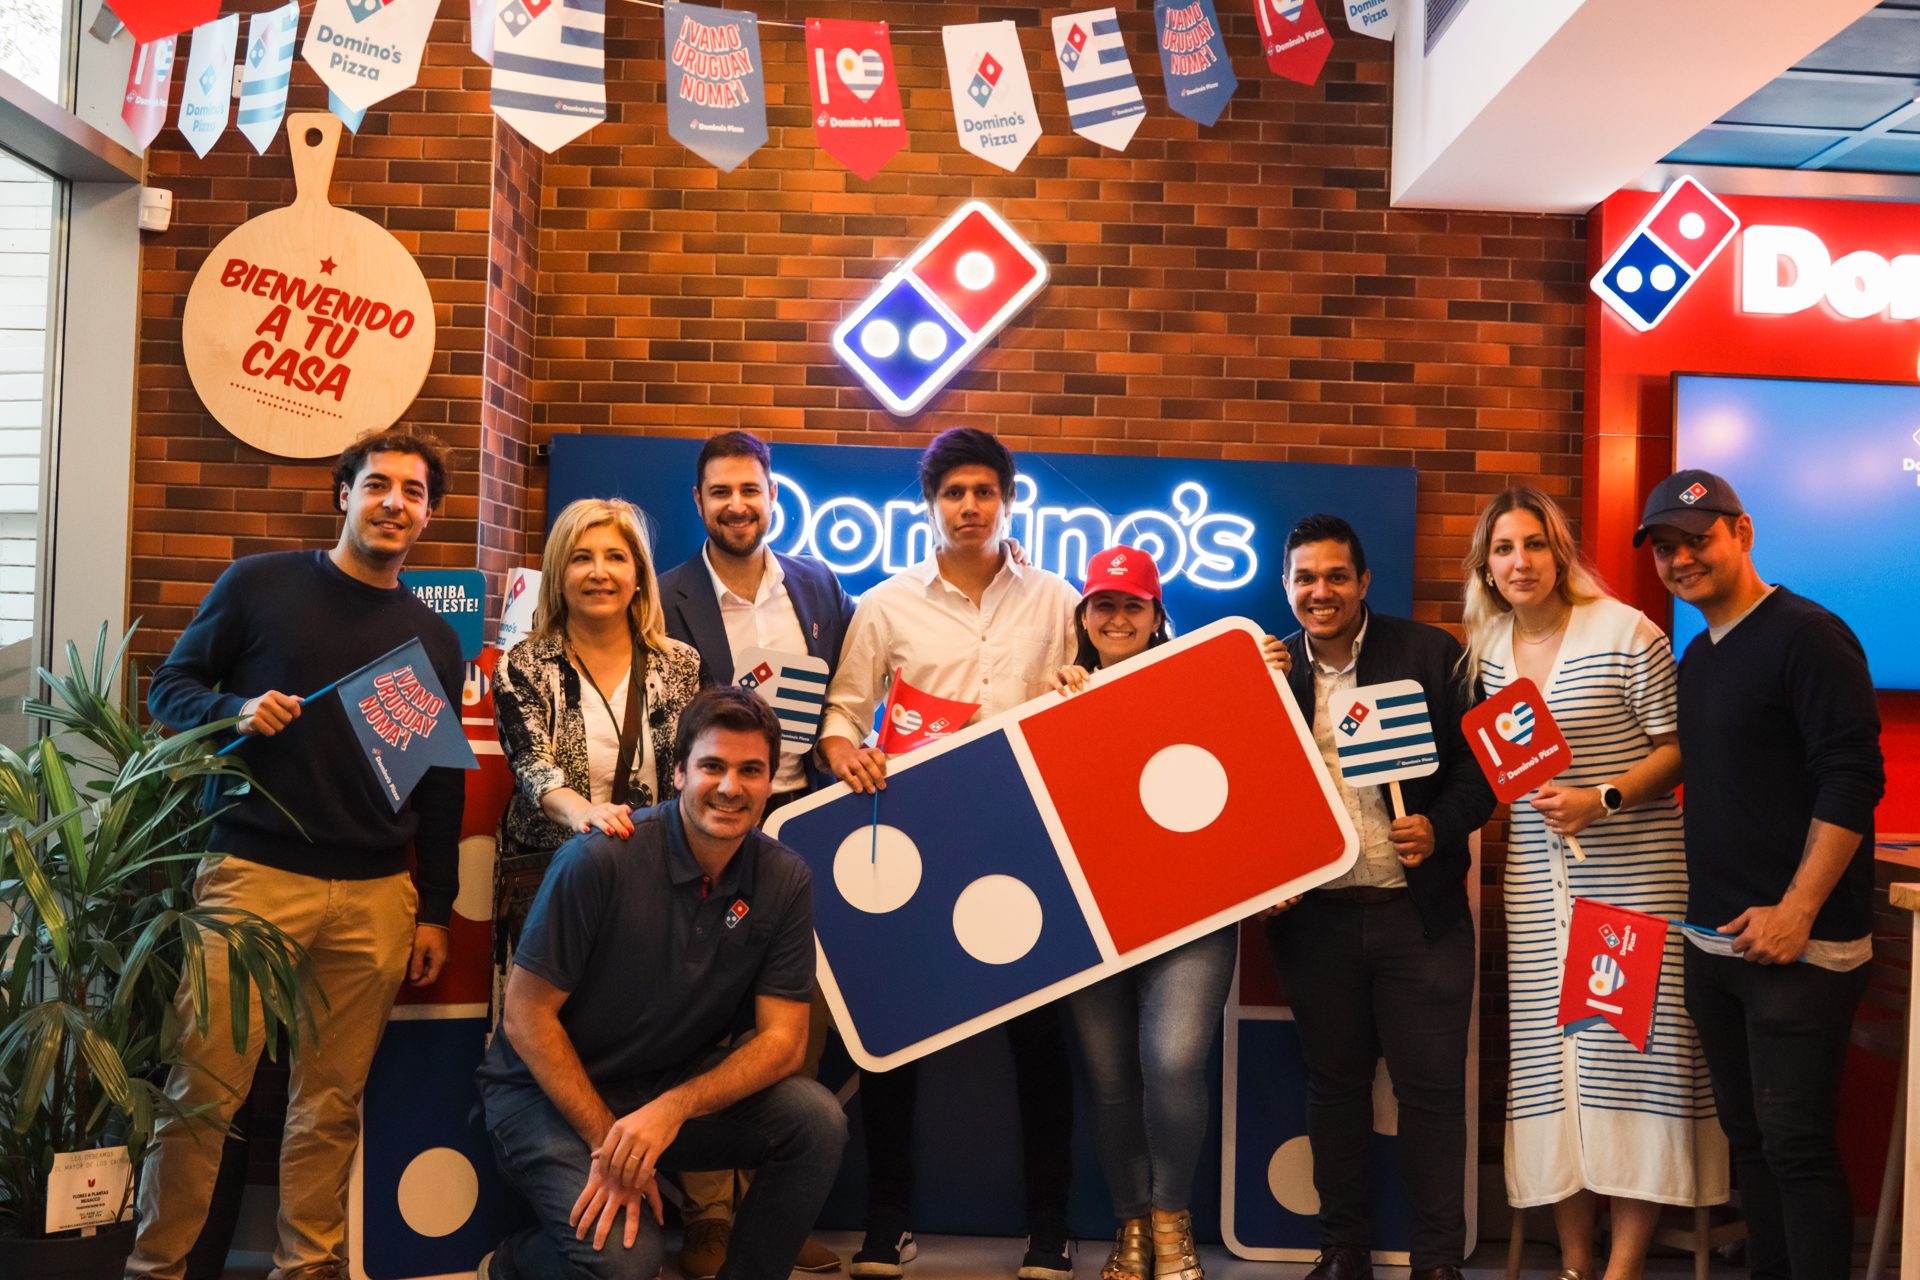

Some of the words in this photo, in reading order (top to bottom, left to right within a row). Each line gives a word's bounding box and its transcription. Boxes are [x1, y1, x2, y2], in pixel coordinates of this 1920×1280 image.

[1165, 1, 1204, 31] ¡VAMO
[1362, 8, 1388, 26] Pizza
[316, 24, 402, 64] Domino's
[680, 15, 741, 53] ¡VAMO'
[1162, 17, 1215, 53] URUGUAY
[1275, 34, 1305, 53] Domino's
[1305, 27, 1325, 40] Pizza
[329, 52, 380, 81] Pizza
[671, 39, 754, 81] URUGUAY
[815, 48, 830, 104] I
[1171, 44, 1217, 76] NOMA'!
[679, 74, 750, 109] NOMA'!
[829, 117, 873, 129] Domino's
[873, 116, 901, 128] Pizza
[963, 111, 1025, 133] Domino's
[980, 133, 1017, 149] Pizza
[220, 258, 415, 339] BIENVENIDO
[255, 303, 292, 342] A
[304, 315, 359, 360] TU
[242, 340, 351, 402] CASA
[421, 598, 479, 613] ELESTE!
[373, 673, 438, 738] URUGUAY
[393, 664, 446, 718] ¡VAMO'
[358, 694, 413, 751] NOMA'!
[781, 733, 799, 741] omino's
[1477, 727, 1503, 768] I
[1507, 756, 1539, 780] Domino's
[1538, 744, 1560, 760] Pizza
[375, 756, 392, 784] Domino's
[389, 783, 400, 801] Pizza
[1619, 924, 1632, 957] Domino's
[1628, 932, 1637, 952] Pizza
[1586, 998, 1624, 1015] I
